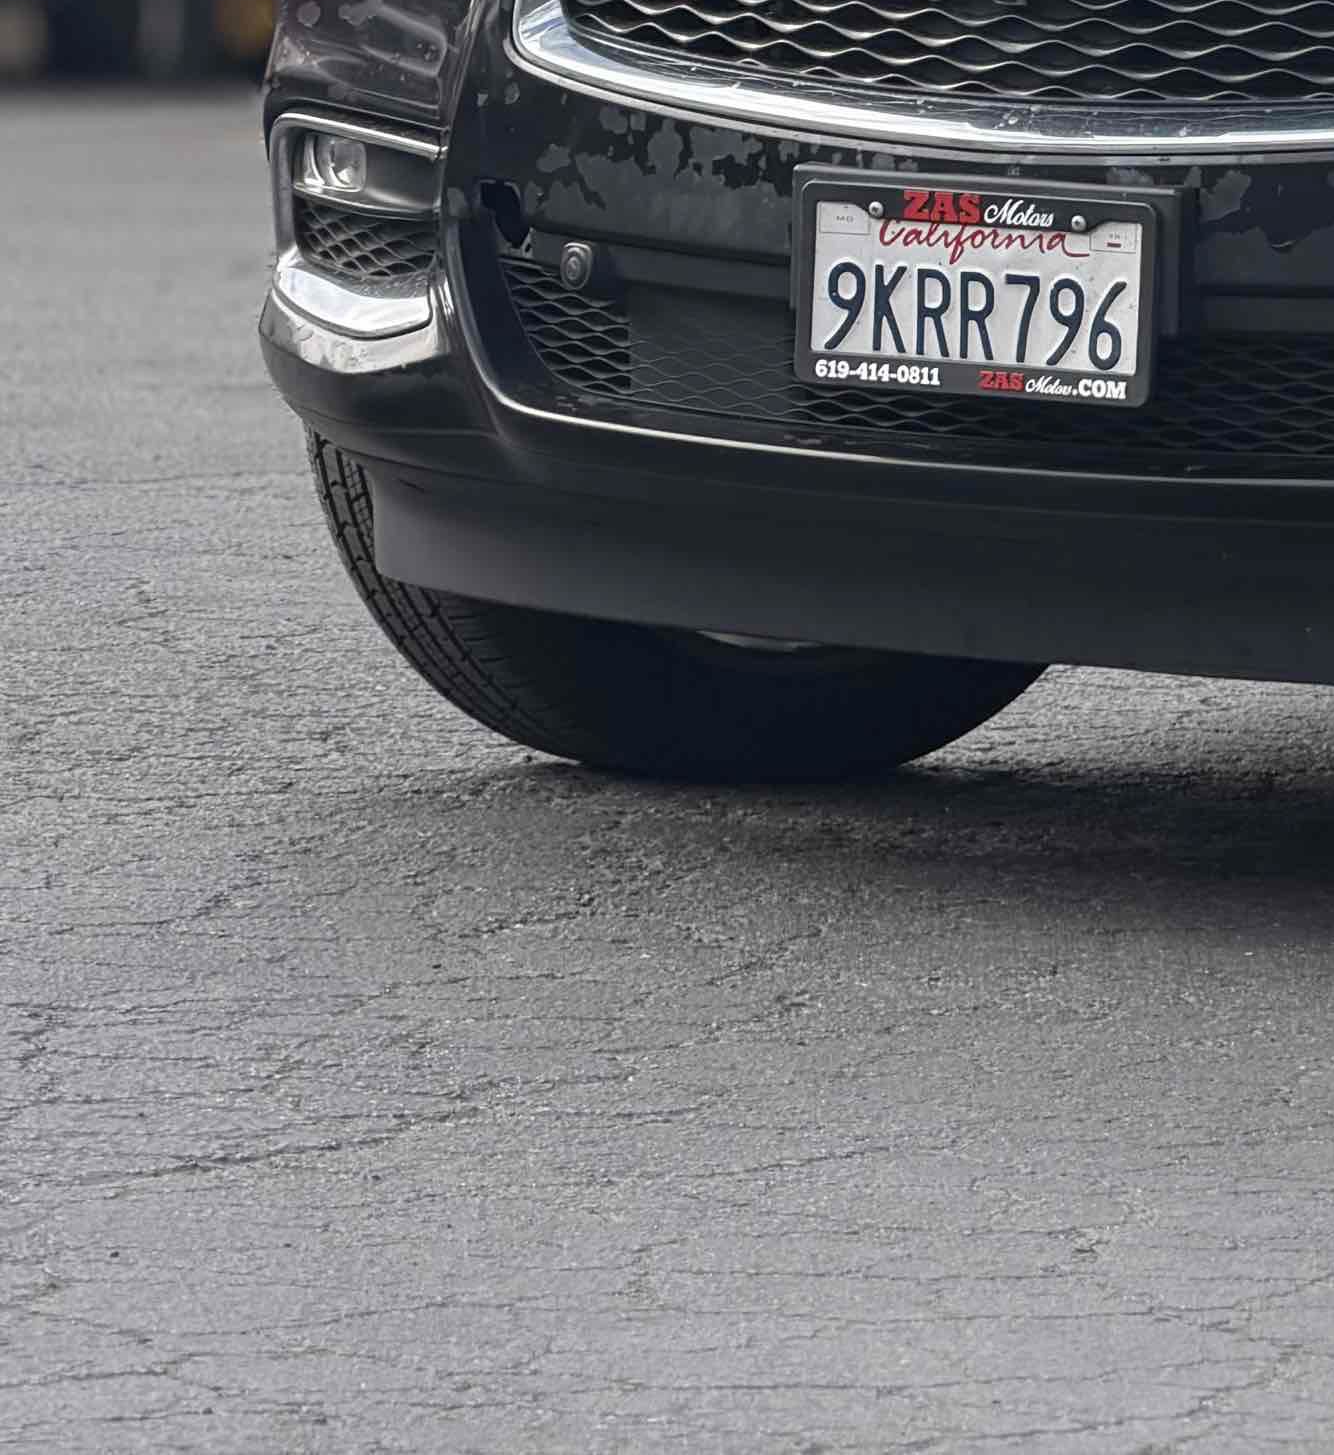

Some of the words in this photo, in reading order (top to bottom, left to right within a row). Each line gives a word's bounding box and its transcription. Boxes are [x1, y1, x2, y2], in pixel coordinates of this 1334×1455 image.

[903, 190, 982, 224] ZAS
[984, 199, 1054, 228] Motors
[879, 219, 1091, 265] California
[824, 260, 1128, 372] 9KRR796
[815, 359, 940, 386] 619-414-0811
[979, 370, 1024, 391] ZAS
